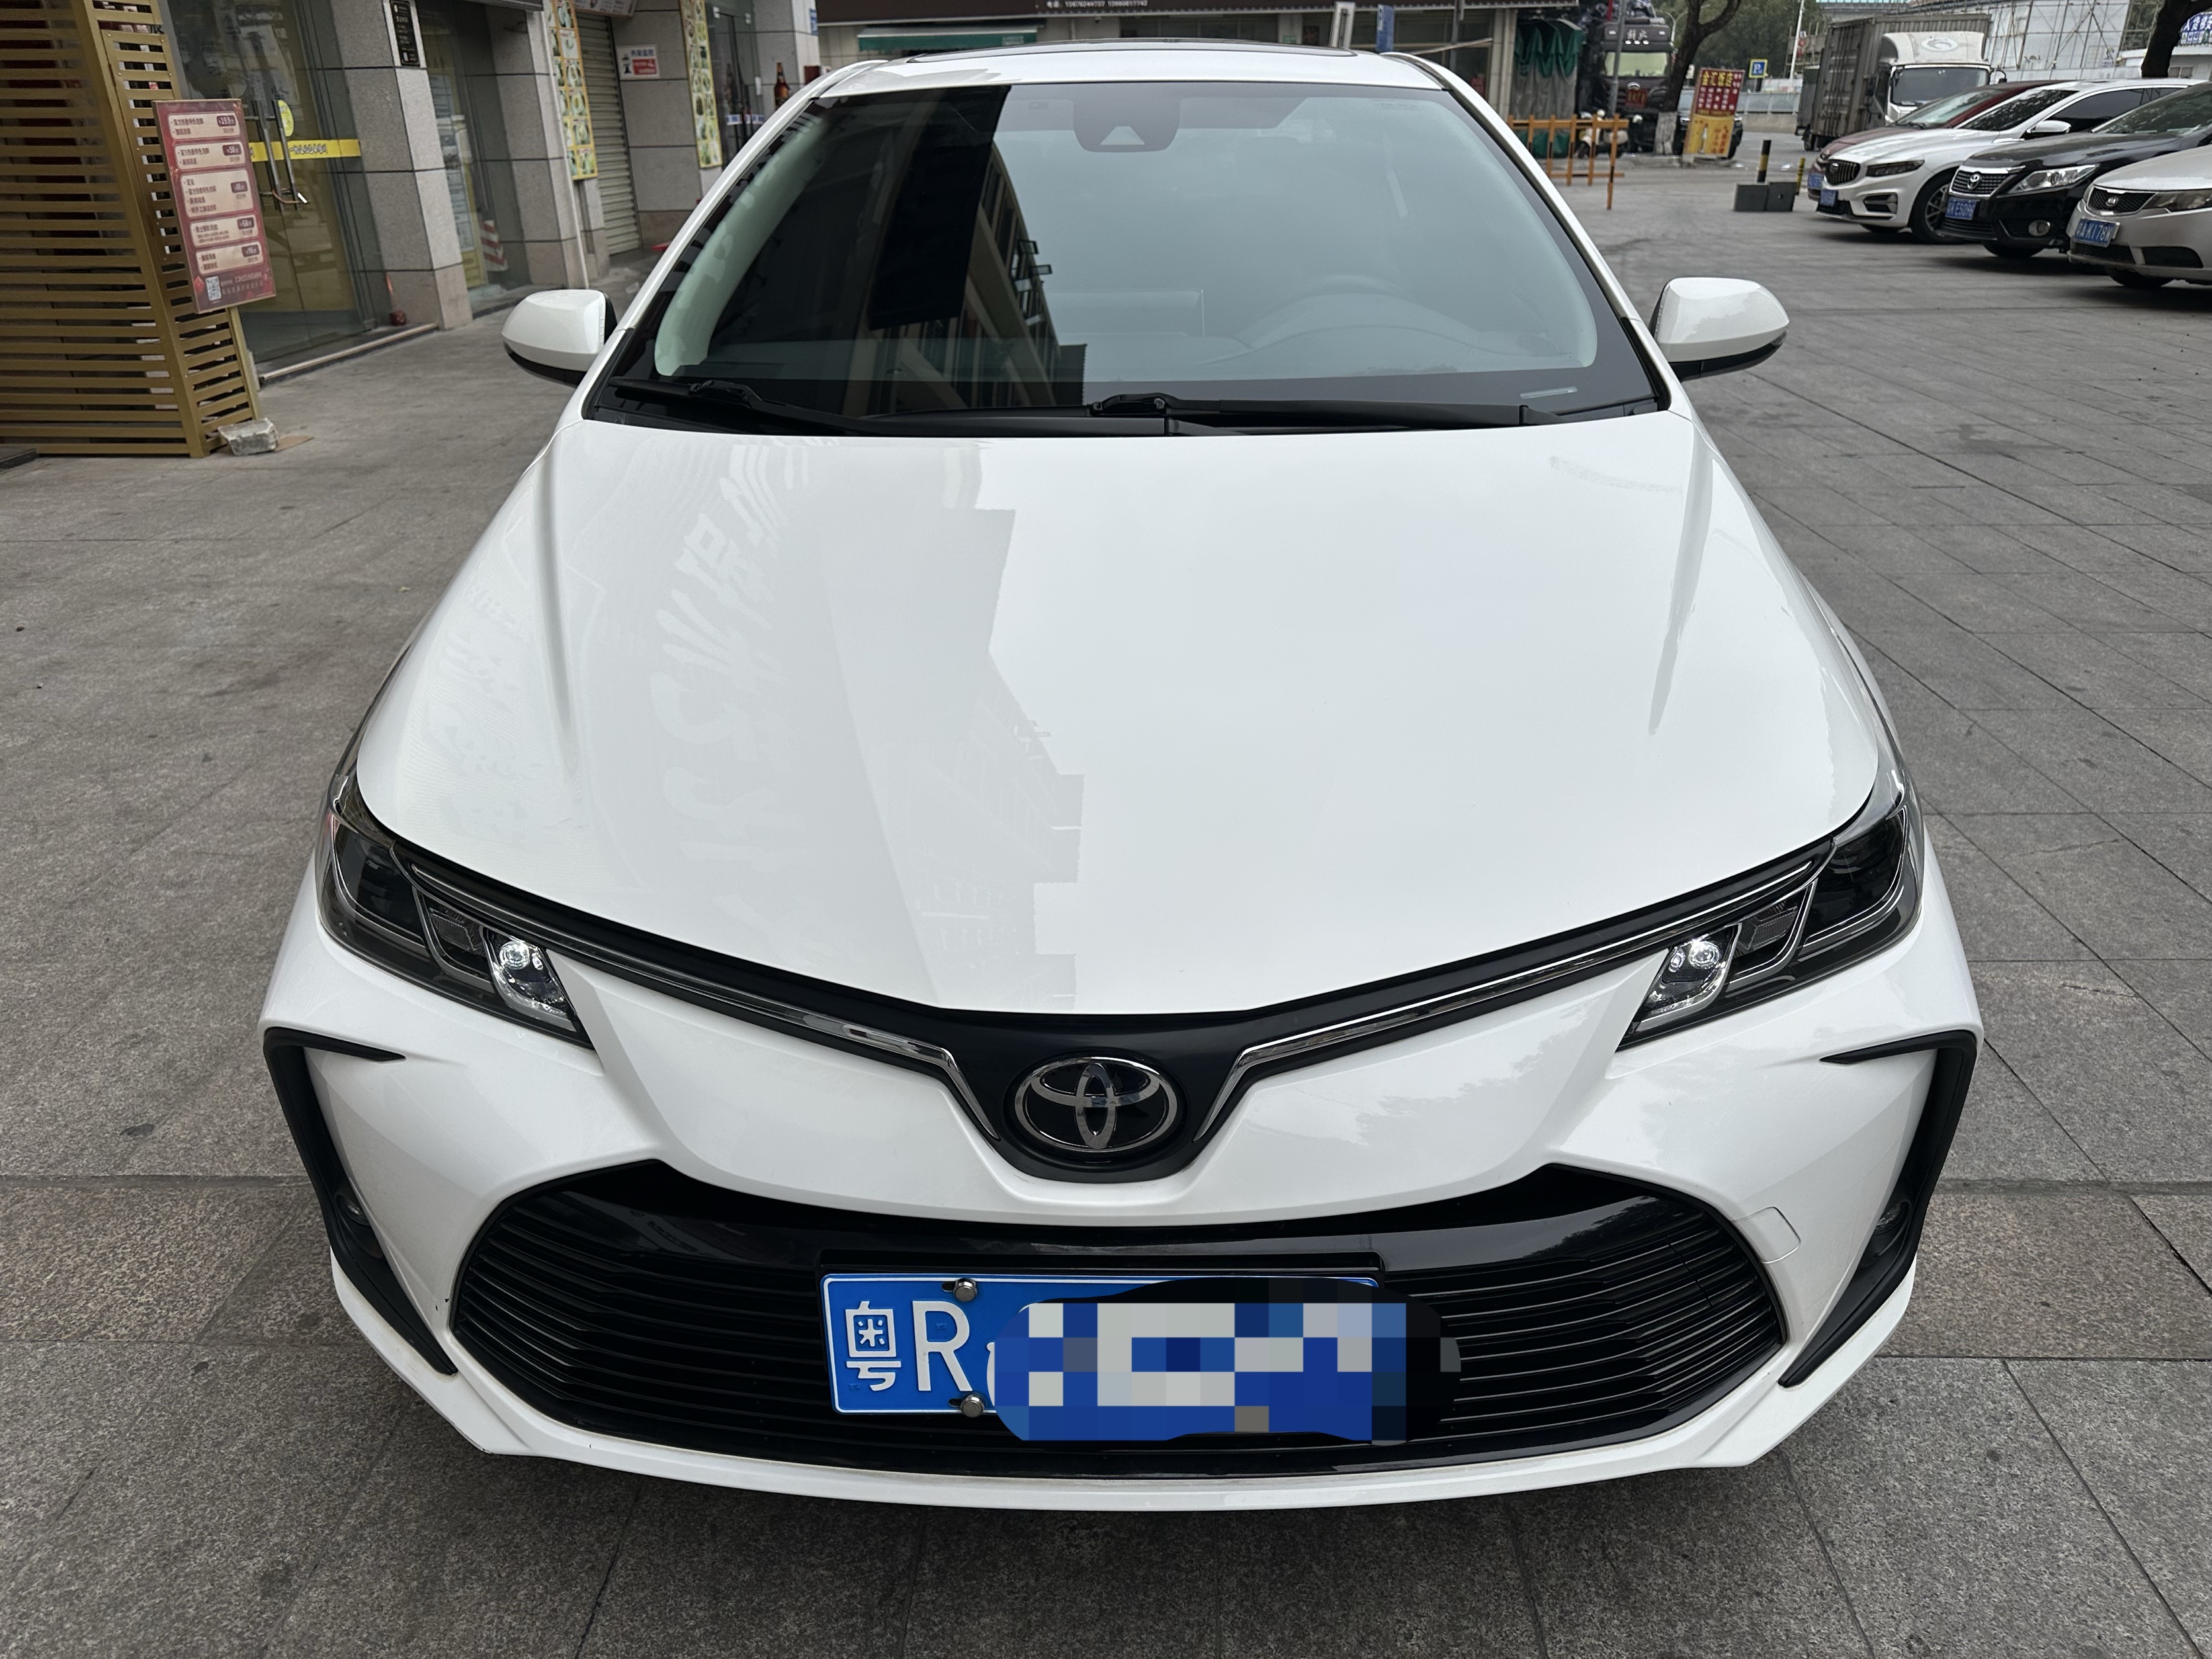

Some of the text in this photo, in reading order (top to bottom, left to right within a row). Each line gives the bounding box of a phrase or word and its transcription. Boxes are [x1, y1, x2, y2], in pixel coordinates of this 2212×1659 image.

[1701, 71, 1734, 87] 金汇饭店
[845, 1301, 973, 1391] 粤R
